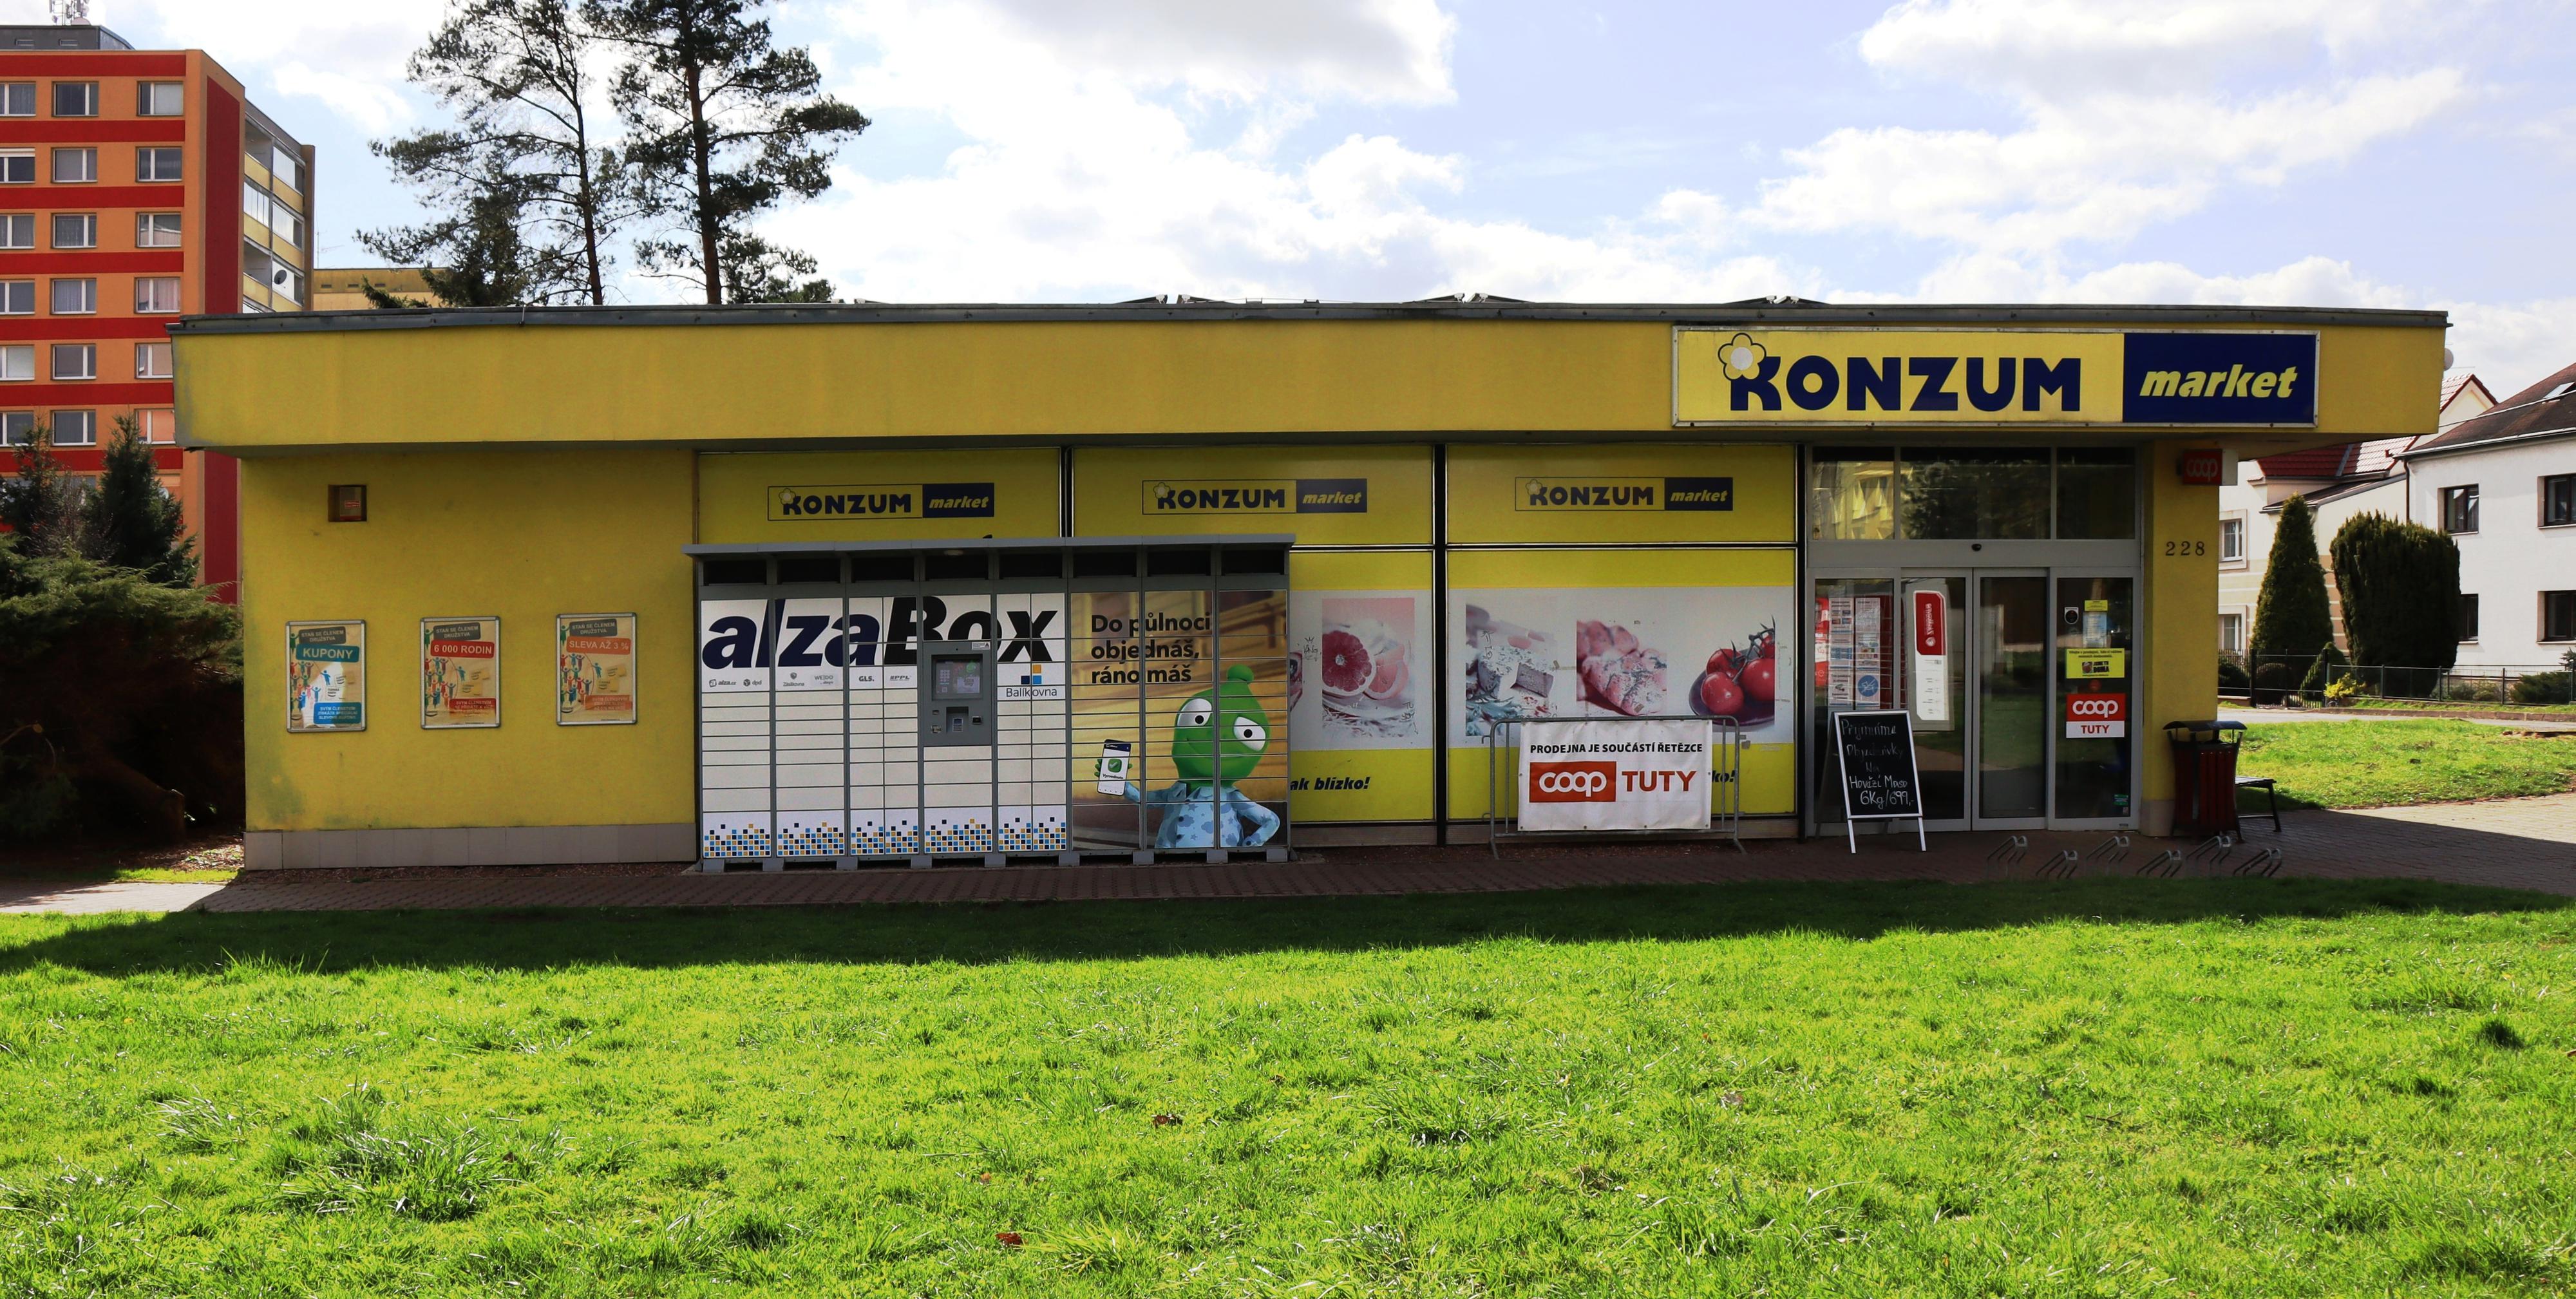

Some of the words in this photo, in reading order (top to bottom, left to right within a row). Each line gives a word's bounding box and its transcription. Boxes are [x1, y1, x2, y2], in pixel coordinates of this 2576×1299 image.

[1730, 354, 2081, 412] KONZUM
[2141, 363, 2298, 398] market
[2186, 458, 2219, 482] coop
[782, 493, 911, 515] KONZUM
[929, 496, 989, 509] market
[1157, 488, 1286, 509] KONZUM
[1302, 490, 1362, 504] market
[1530, 486, 1654, 506] KONZUM
[1670, 489, 1728, 503] market
[2165, 541, 2206, 556] 228
[702, 596, 1058, 669] alzaBox
[1090, 614, 1123, 633] Do
[1128, 612, 1211, 635] půlnoci
[303, 647, 354, 659] KUPONY
[434, 645, 439, 653] 6
[442, 645, 458, 654] 000
[461, 645, 492, 654] RODIN
[569, 640, 598, 649] SLEVA
[599, 640, 612, 650] AŽ
[621, 642, 629, 650] %
[1090, 640, 1200, 663] objednáš,
[1090, 668, 1141, 685] ráno
[1146, 665, 1192, 684] máš
[1005, 686, 1058, 698] Balíkovna
[2072, 699, 2119, 718] coop
[2080, 725, 2110, 734] TUTY
[1530, 744, 1586, 754] PRODEJNA
[1588, 744, 1600, 753] JE
[1602, 742, 1655, 753] SOUČÁSTÍ
[1658, 742, 1703, 753] ŘETĚZCE
[1290, 777, 1310, 791] ak
[1314, 776, 1371, 791] blízko!
[1539, 771, 1607, 797] coop
[1622, 770, 1697, 792] TUTY
